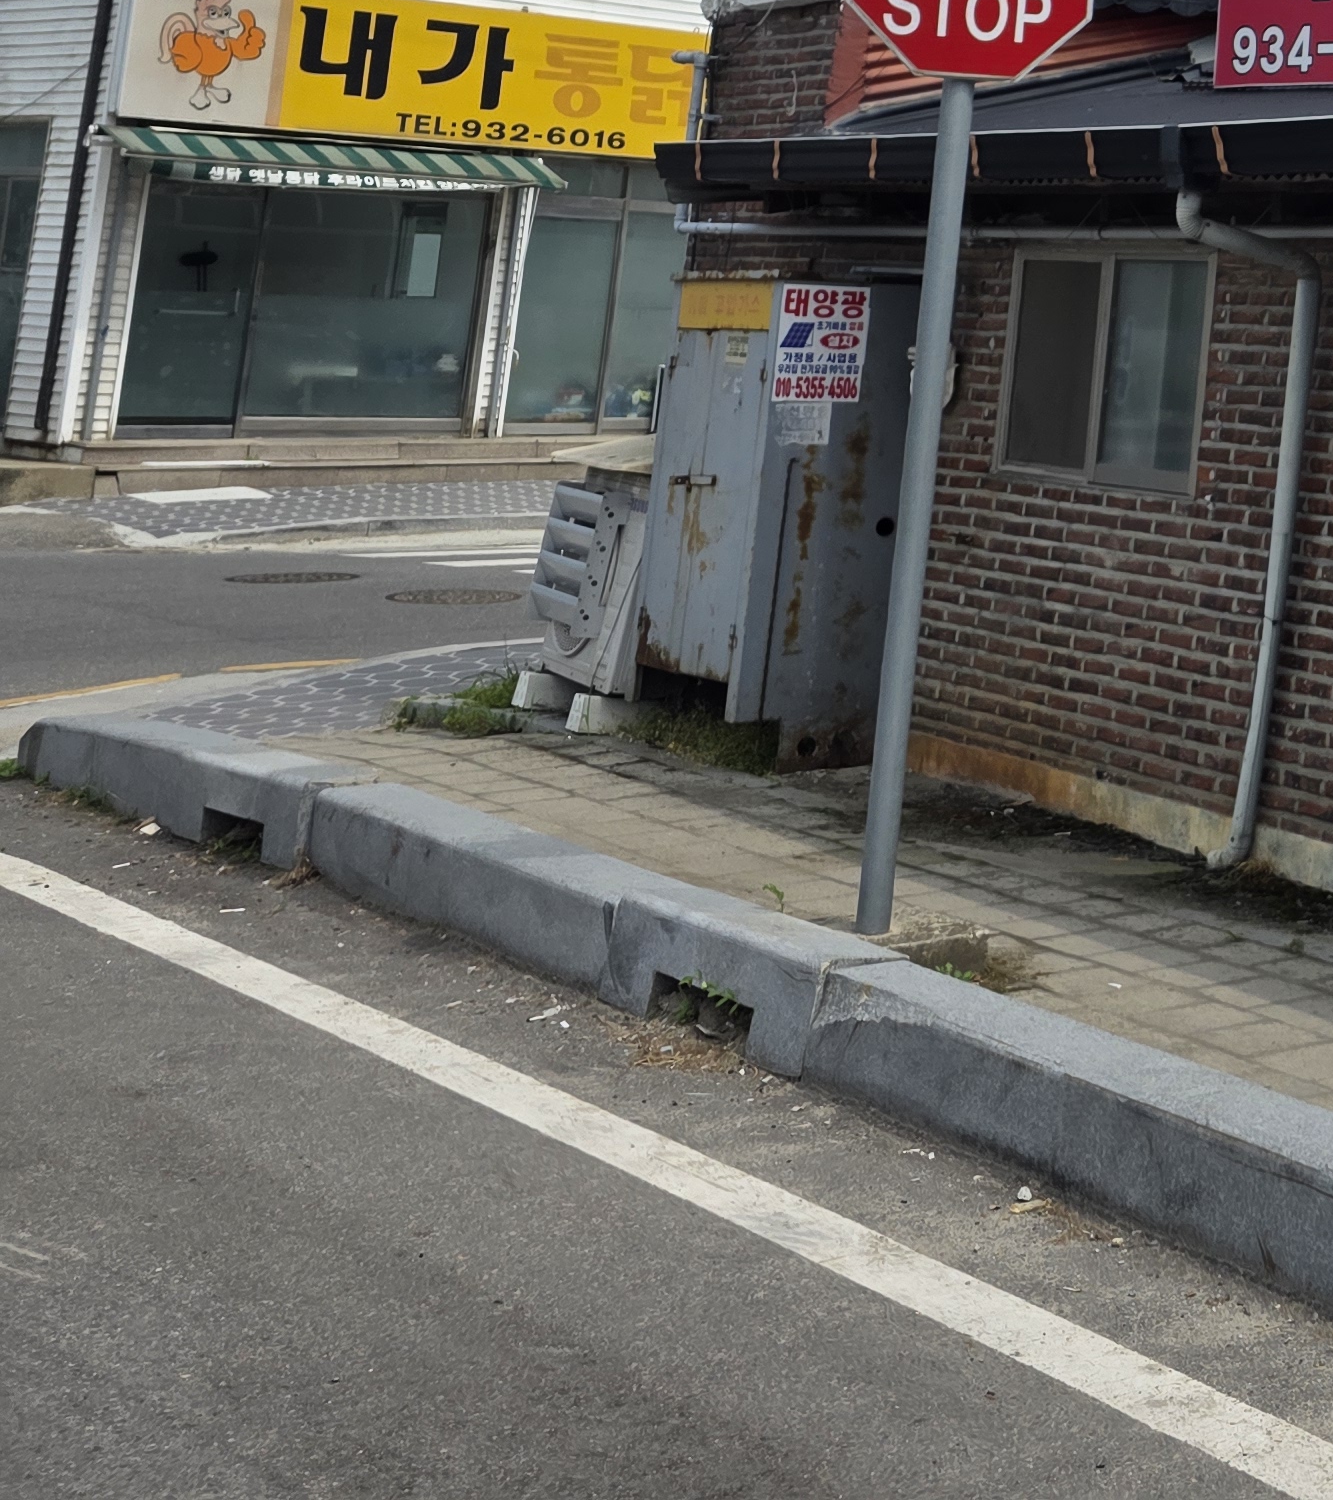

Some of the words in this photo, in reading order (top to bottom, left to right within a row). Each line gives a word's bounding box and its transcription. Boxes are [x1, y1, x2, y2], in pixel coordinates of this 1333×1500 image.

[299, 5, 515, 111] 내가
[396, 112, 626, 150] TEL:932-6016
[784, 289, 867, 319] 태양광
[783, 352, 814, 363] 가정용
[826, 352, 858, 364] 사업용
[775, 376, 858, 399] 010-5355-4506
